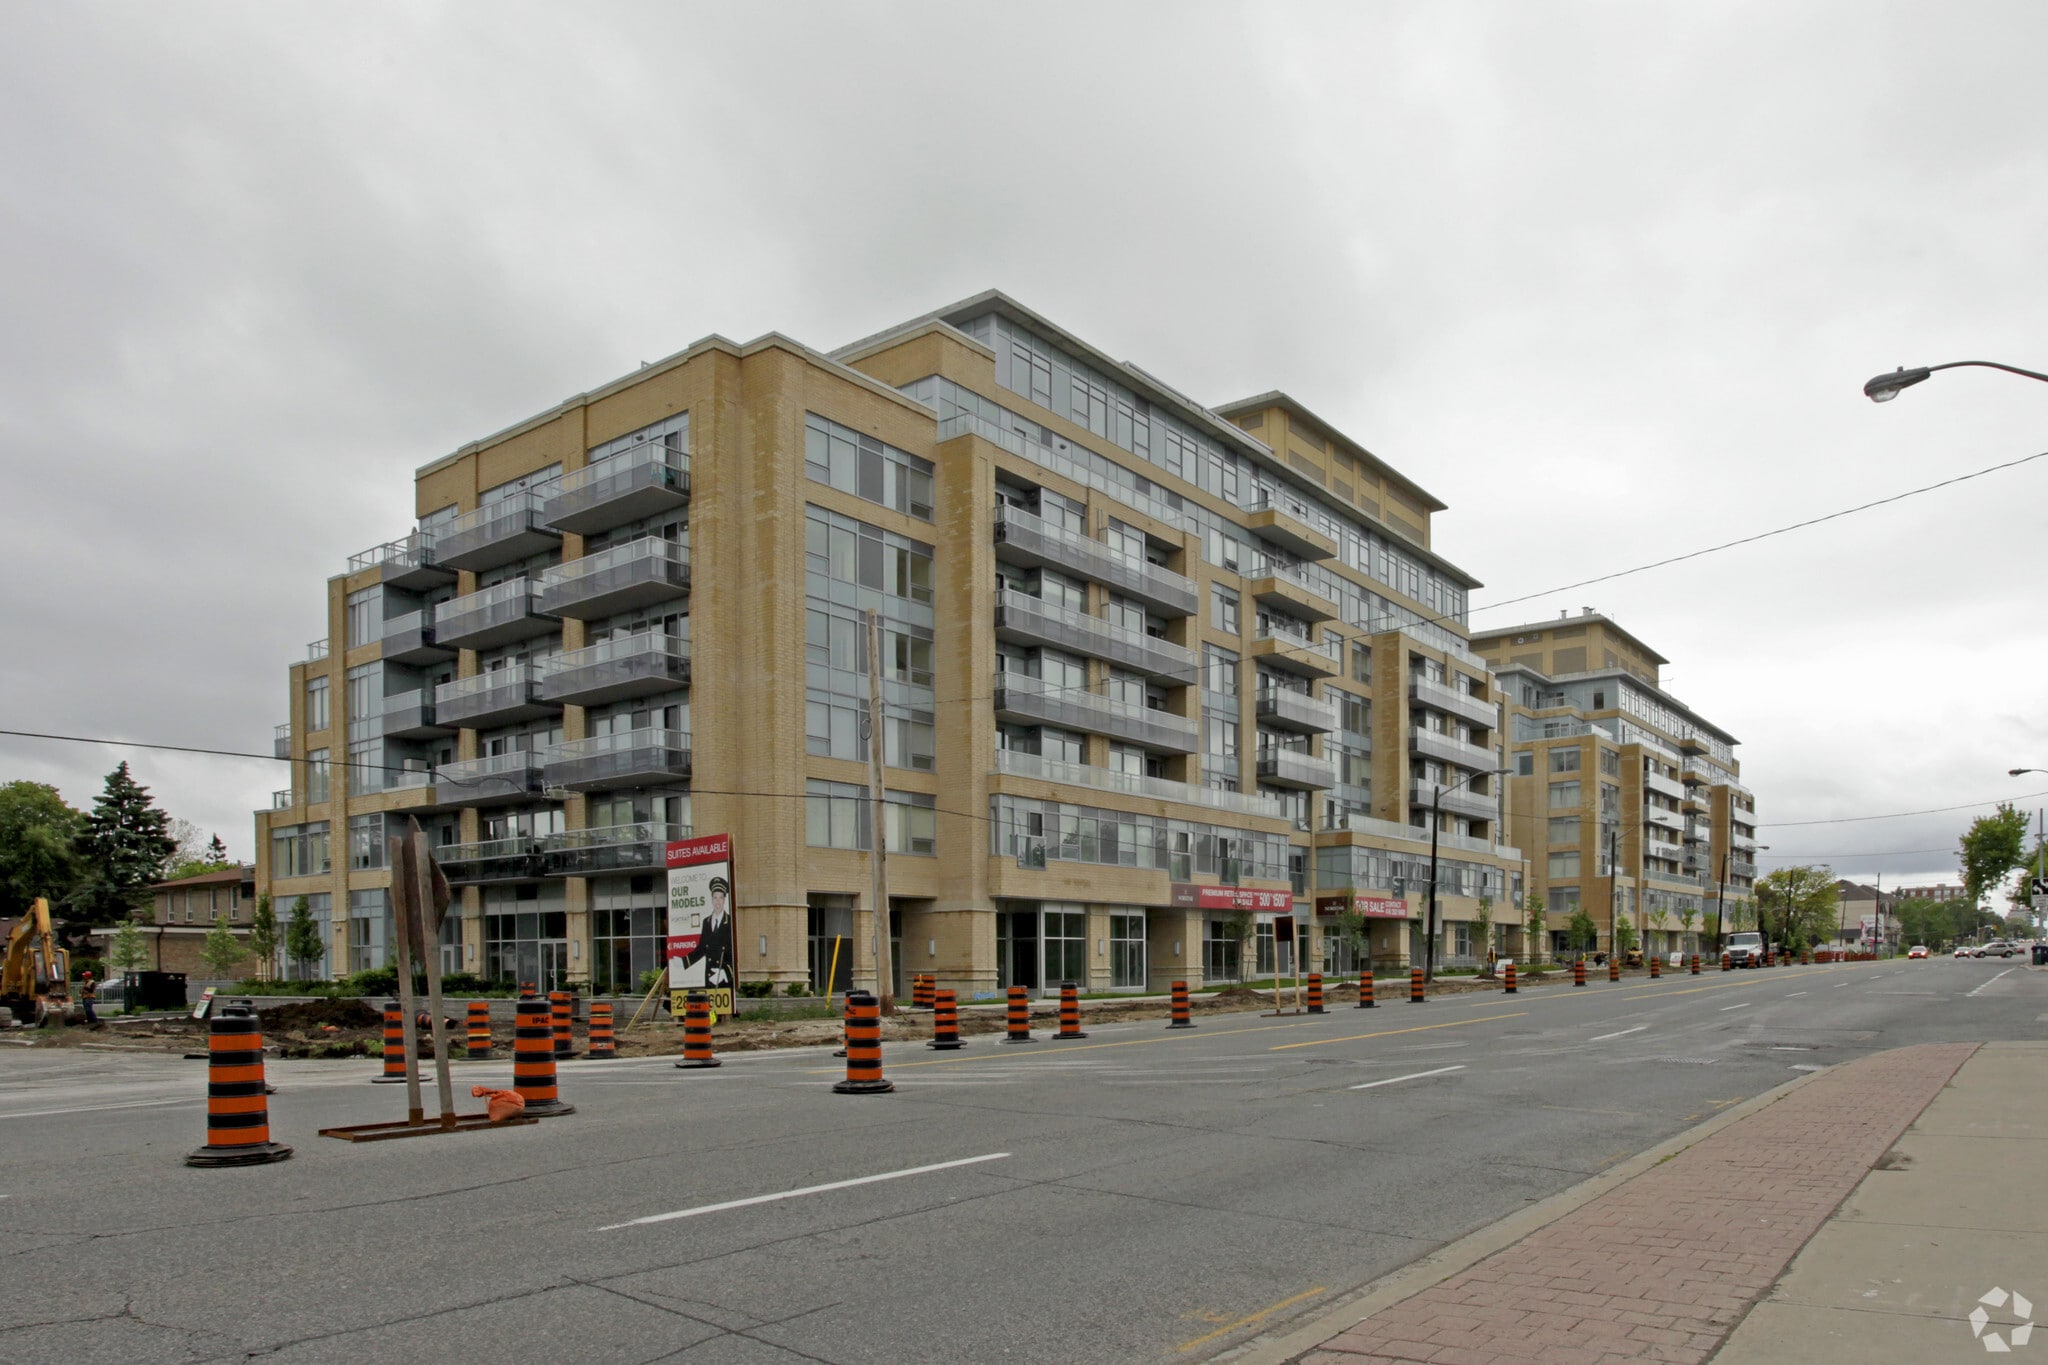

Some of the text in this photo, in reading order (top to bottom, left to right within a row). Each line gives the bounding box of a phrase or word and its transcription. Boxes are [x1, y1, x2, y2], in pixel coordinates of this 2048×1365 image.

[667, 841, 727, 860] SUITES AVAILABLE
[671, 874, 699, 884] WELCOME
[671, 886, 689, 897] OUR
[1202, 888, 1223, 897] PREMIUM
[671, 896, 706, 909] MODELS
[1259, 893, 1270, 906] 500
[1273, 894, 1285, 907] 1500
[1369, 901, 1385, 913] SALE
[673, 941, 697, 950] PARKING
[532, 1016, 549, 1024] IPAC
